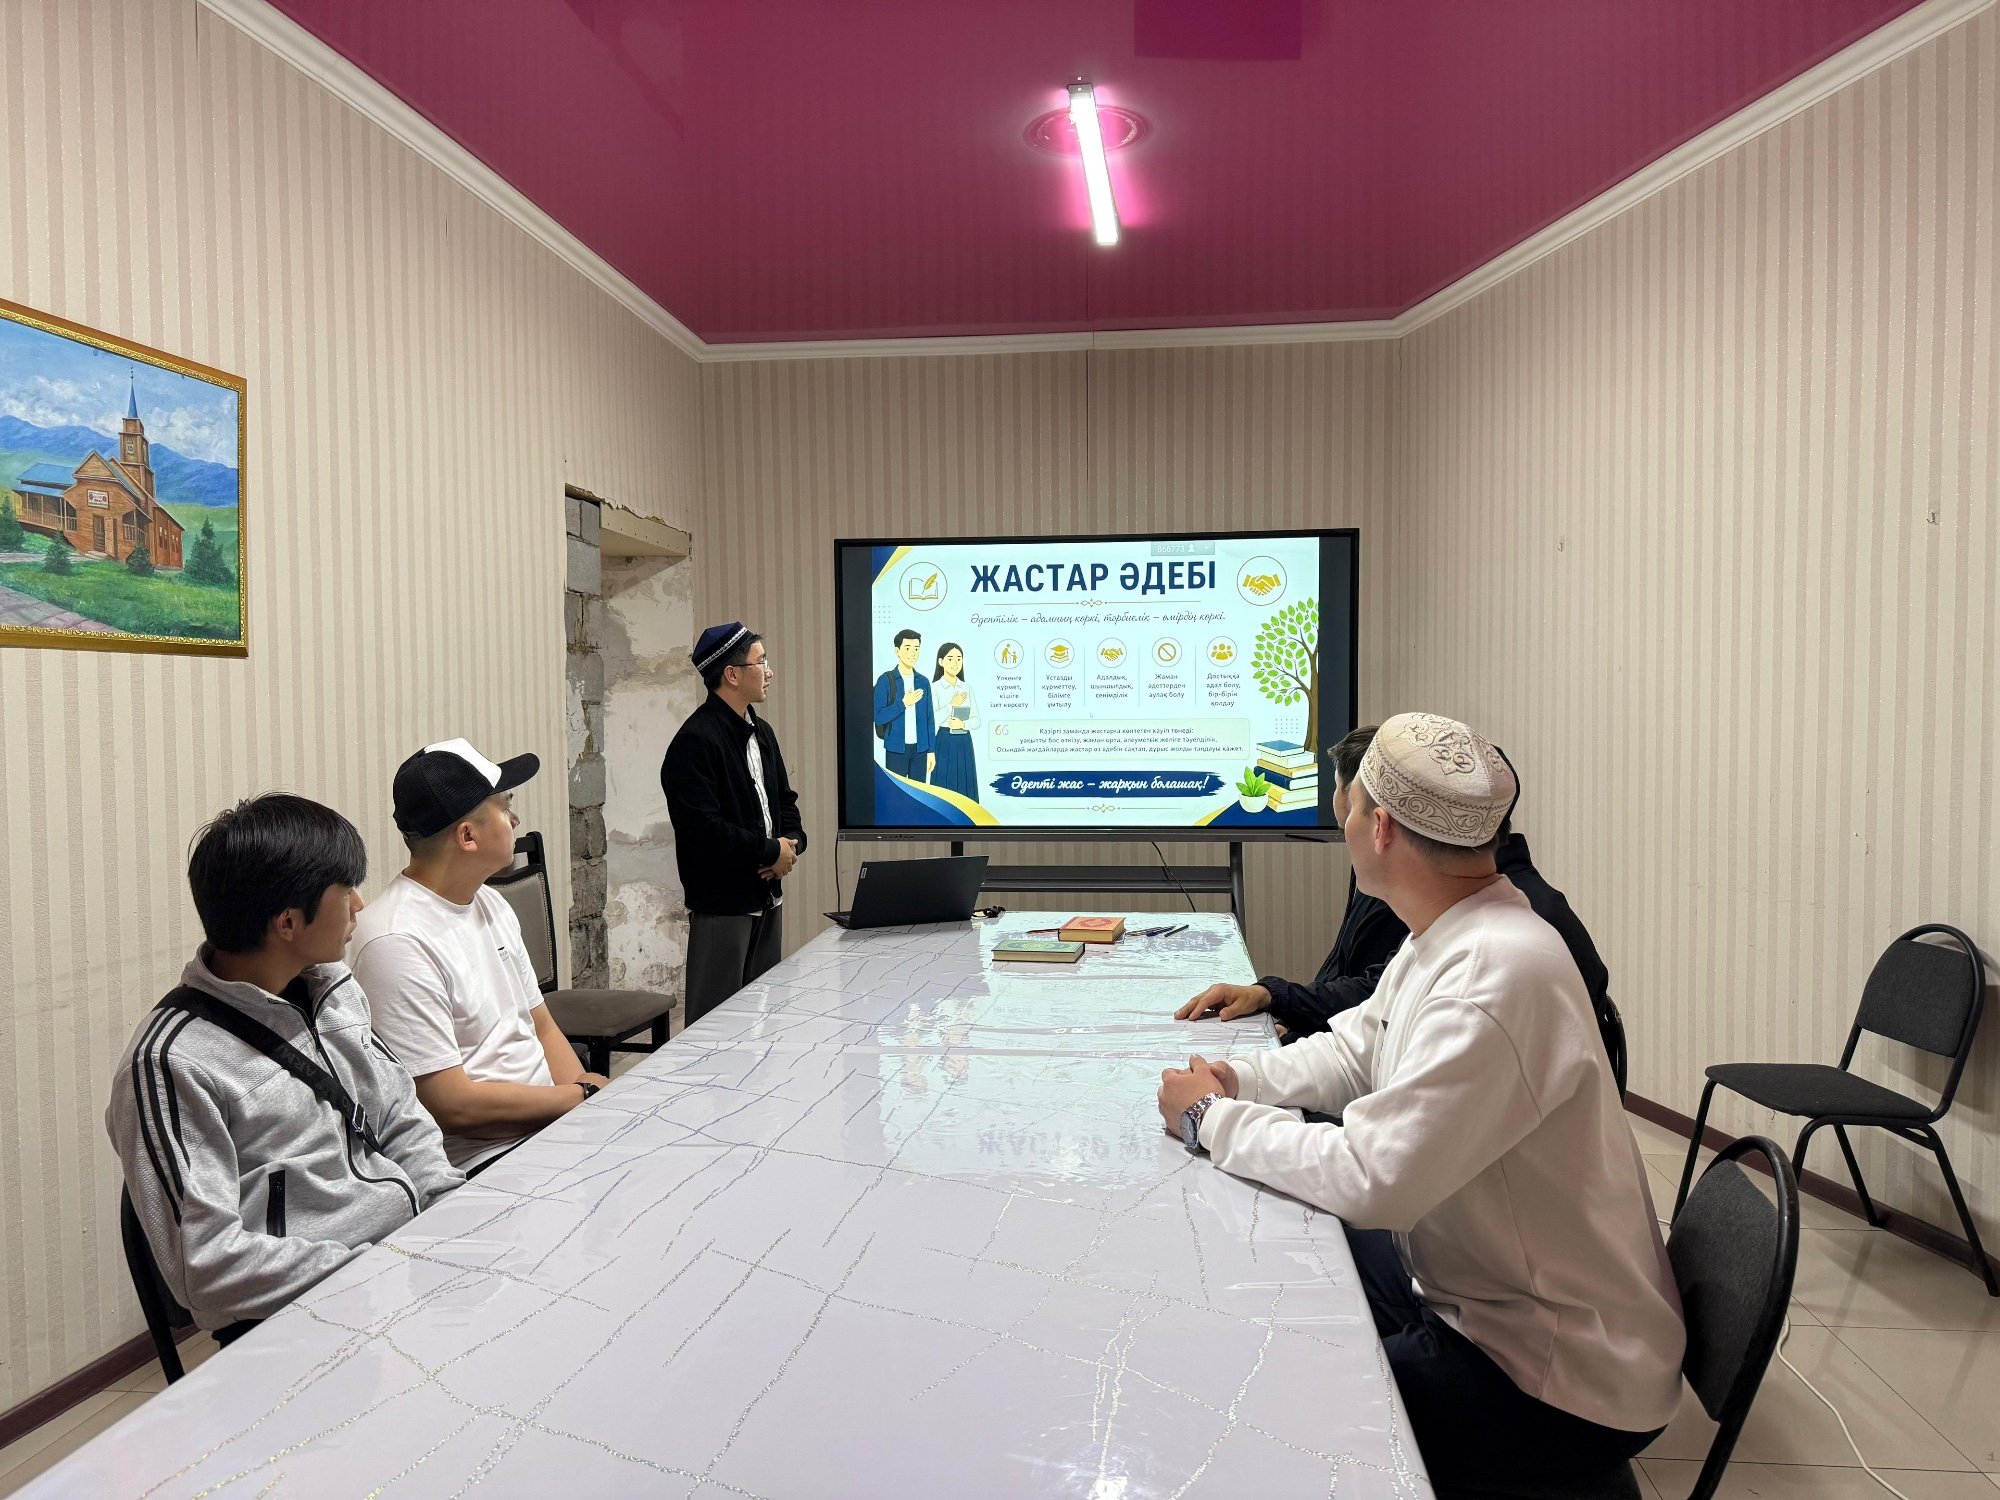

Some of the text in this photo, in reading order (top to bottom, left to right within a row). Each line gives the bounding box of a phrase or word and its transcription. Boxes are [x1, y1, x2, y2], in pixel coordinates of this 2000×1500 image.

[970, 561, 1216, 596] ЖАСТАР ӘДЕБІ
[970, 613, 1018, 628] Әдептілік
[1030, 612, 1072, 625] адамның
[1074, 613, 1100, 626] көркі,
[1103, 611, 1151, 626] тәрбиелік
[1162, 610, 1197, 625] өмірдің
[1011, 775, 1056, 794] Әдепті
[1057, 780, 1085, 789] жас
[1098, 778, 1149, 794] жарқын
[1150, 775, 1210, 791] болашақ!
